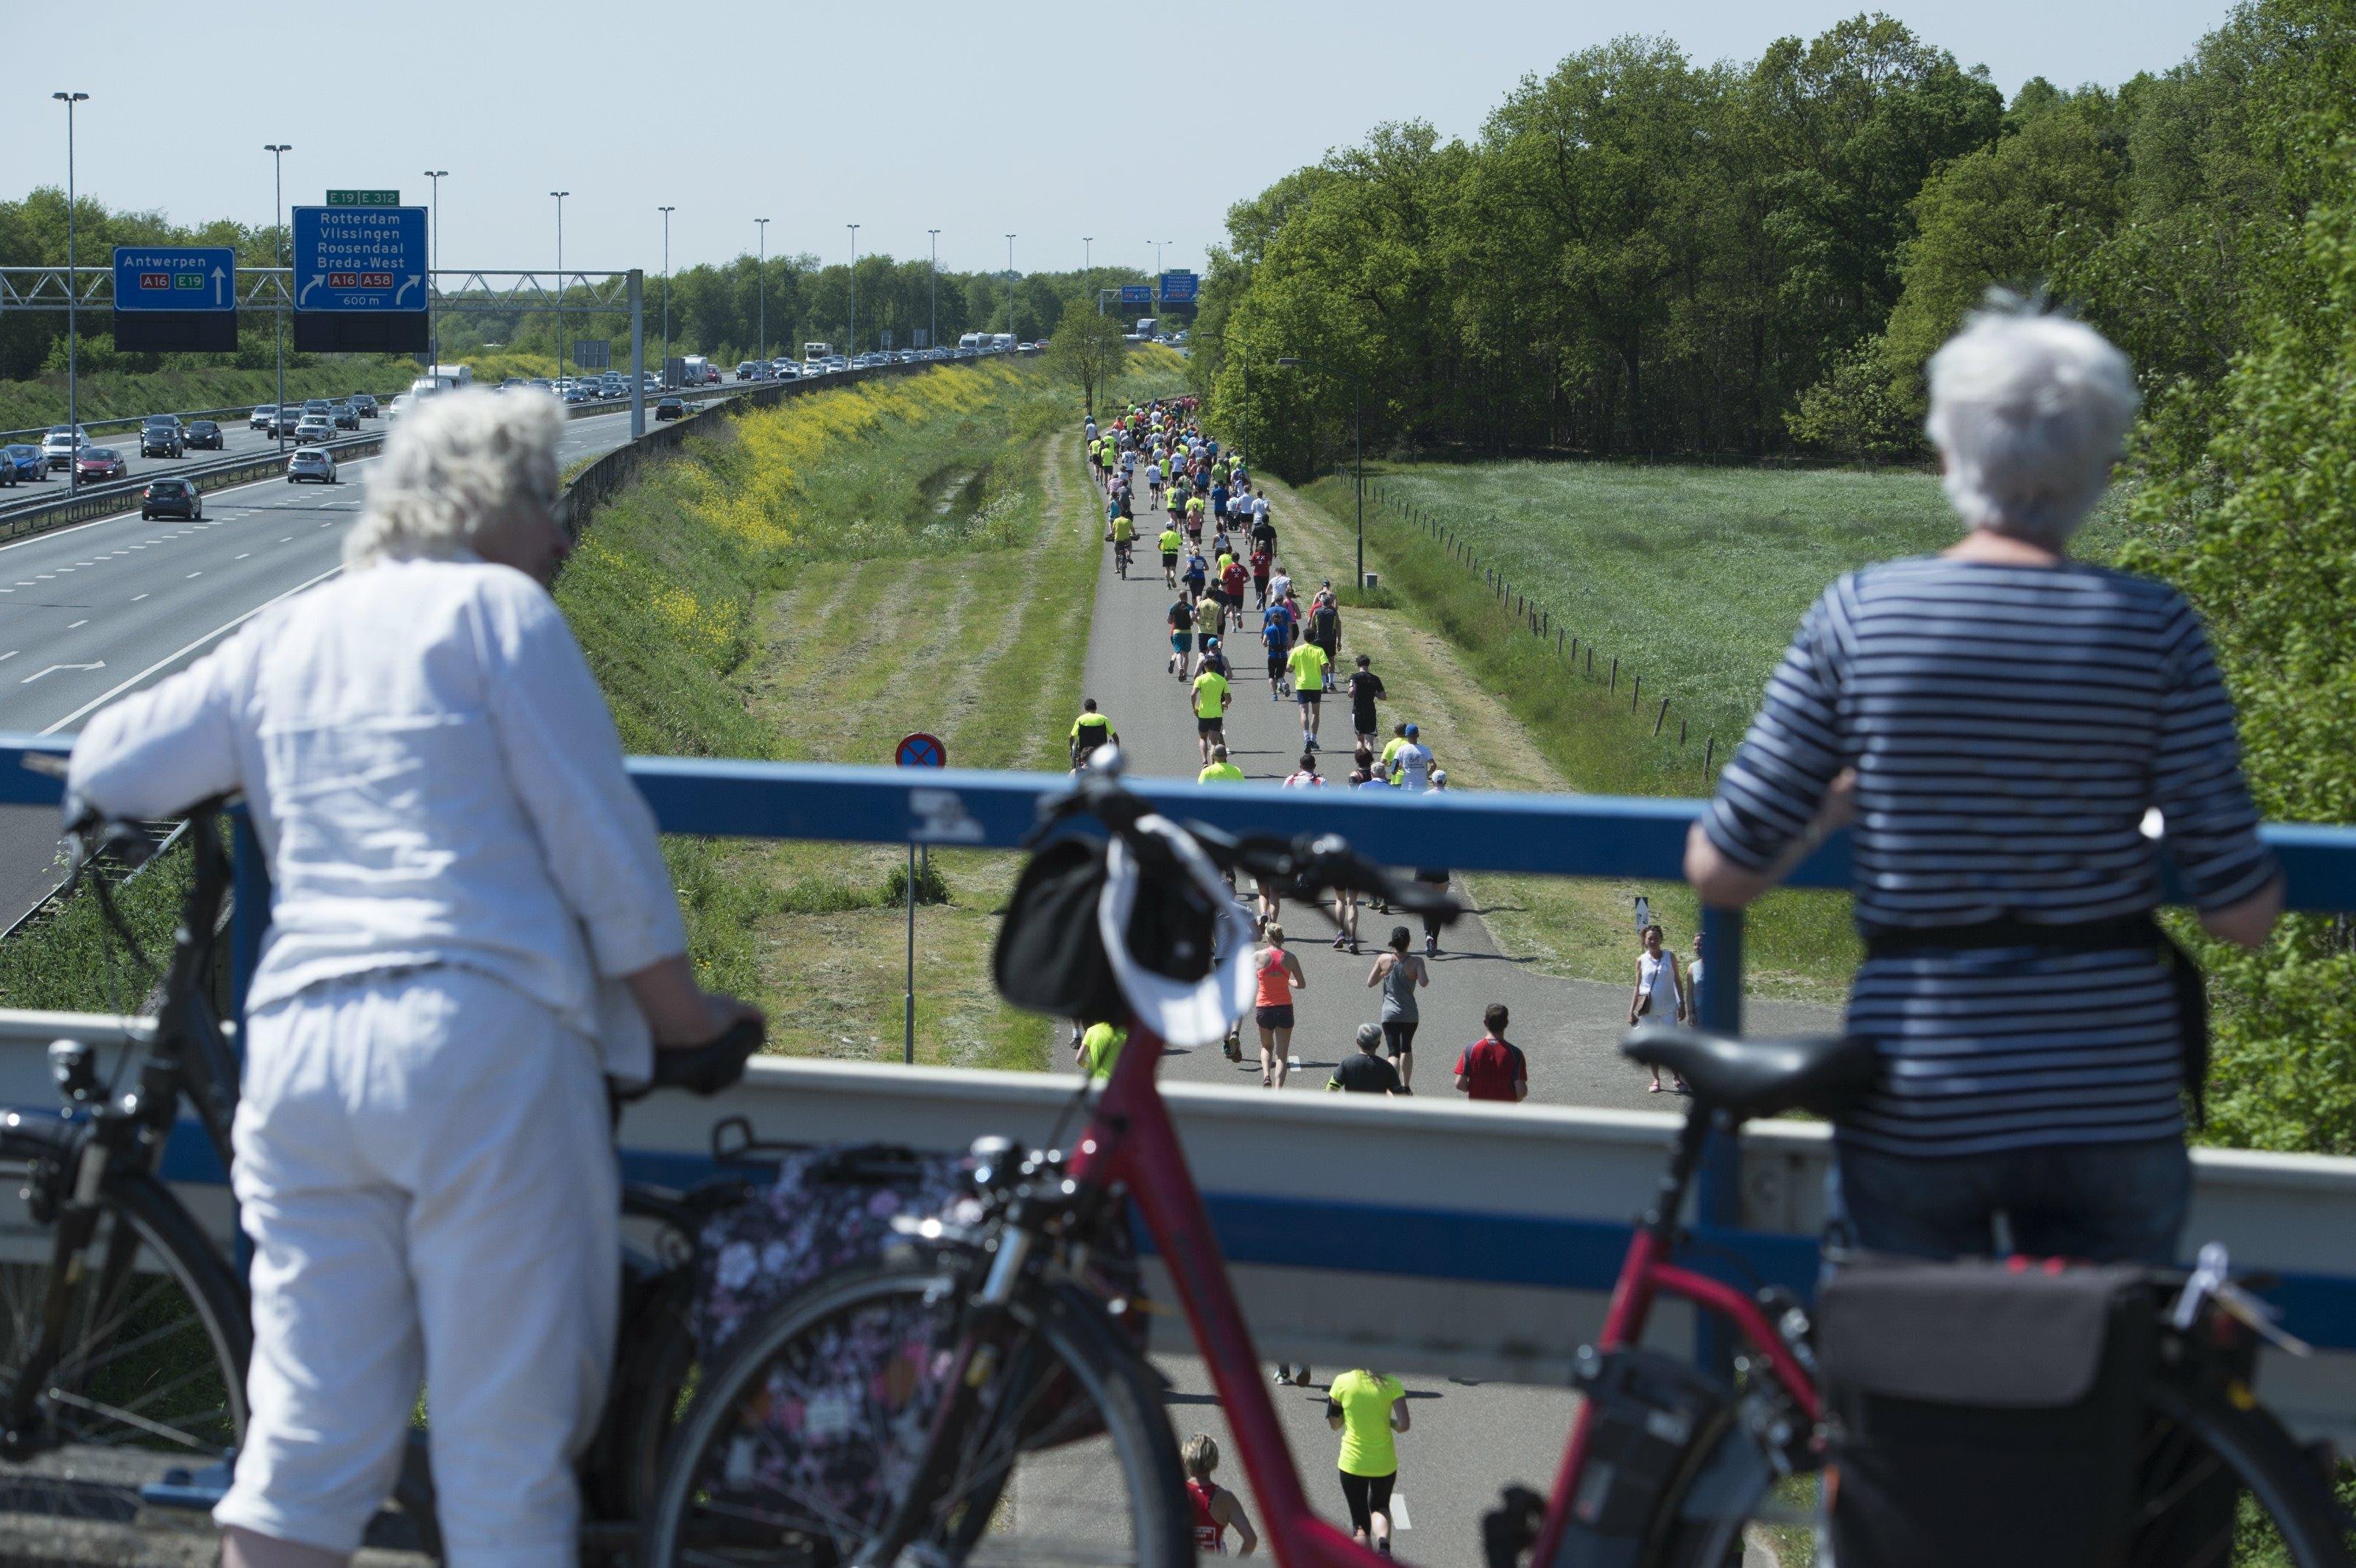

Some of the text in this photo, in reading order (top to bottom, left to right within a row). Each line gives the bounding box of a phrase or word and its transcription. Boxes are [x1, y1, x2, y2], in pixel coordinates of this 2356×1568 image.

[331, 194, 354, 202] E 19
[362, 194, 395, 202] E 312
[320, 213, 400, 225] Rotterdam
[320, 227, 400, 241] Vlissingen
[318, 243, 403, 254] Roosendaal
[124, 256, 206, 269] Antwerpen
[318, 257, 404, 269] Breda-West
[144, 277, 167, 286] A16
[331, 275, 390, 285] A16 A58
[343, 297, 379, 306] 600 m
[1126, 456, 1132, 464] 23
